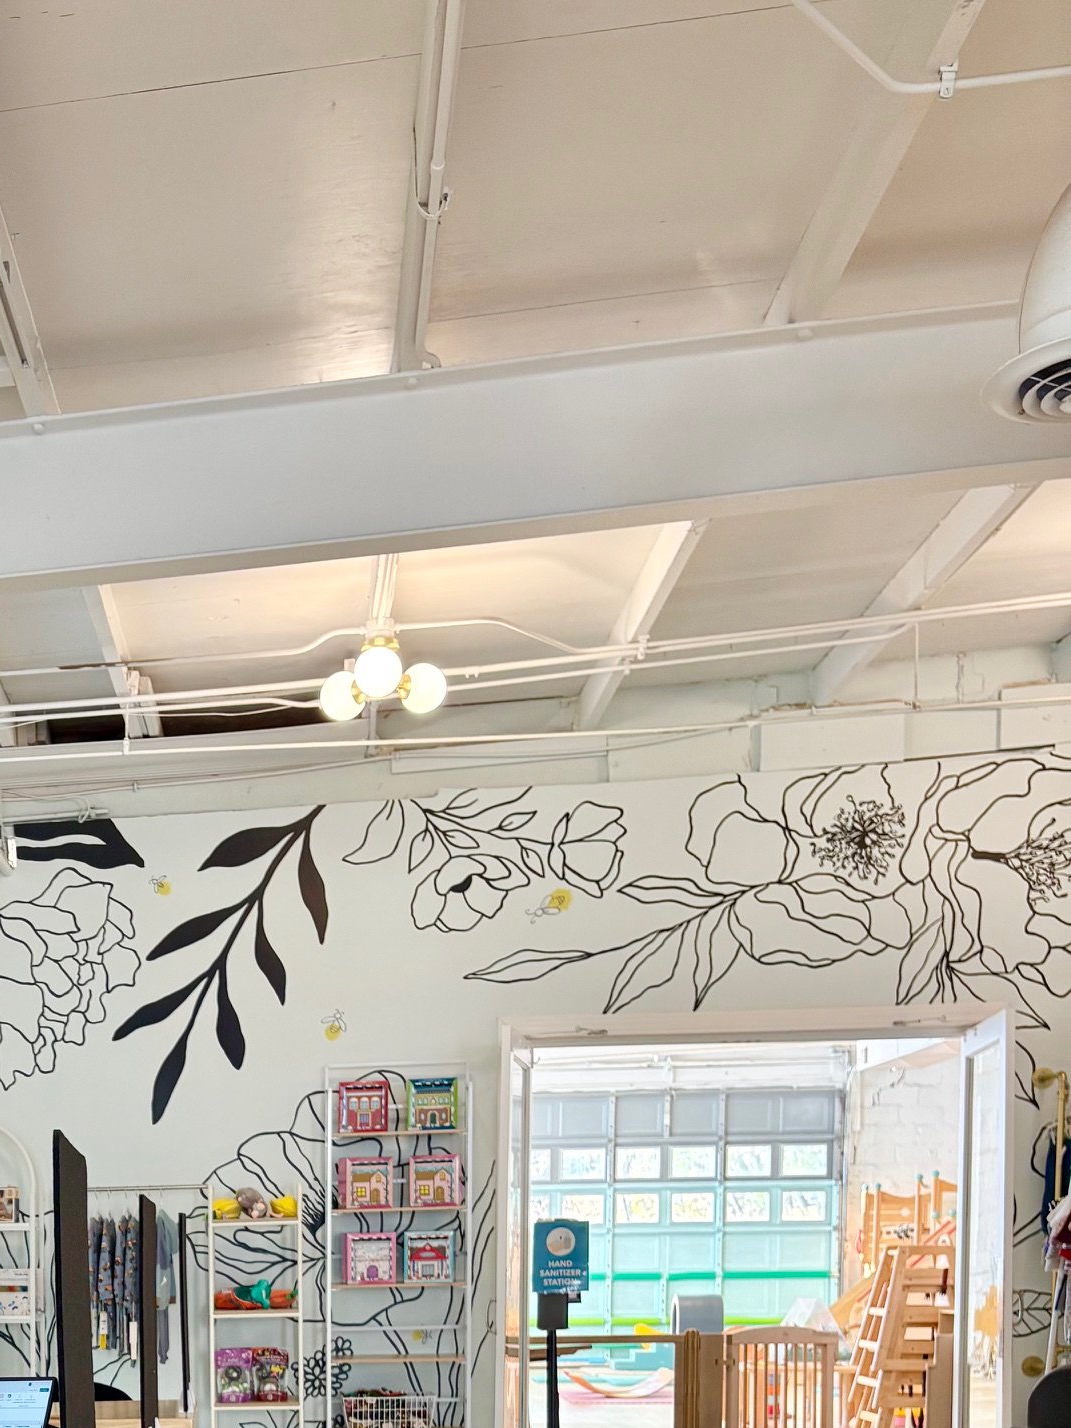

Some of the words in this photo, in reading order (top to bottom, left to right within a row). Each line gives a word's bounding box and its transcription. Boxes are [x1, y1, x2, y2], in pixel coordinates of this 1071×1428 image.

[548, 1260, 573, 1268] HAND
[539, 1269, 581, 1277] SANITIZER
[543, 1278, 578, 1286] STATION
